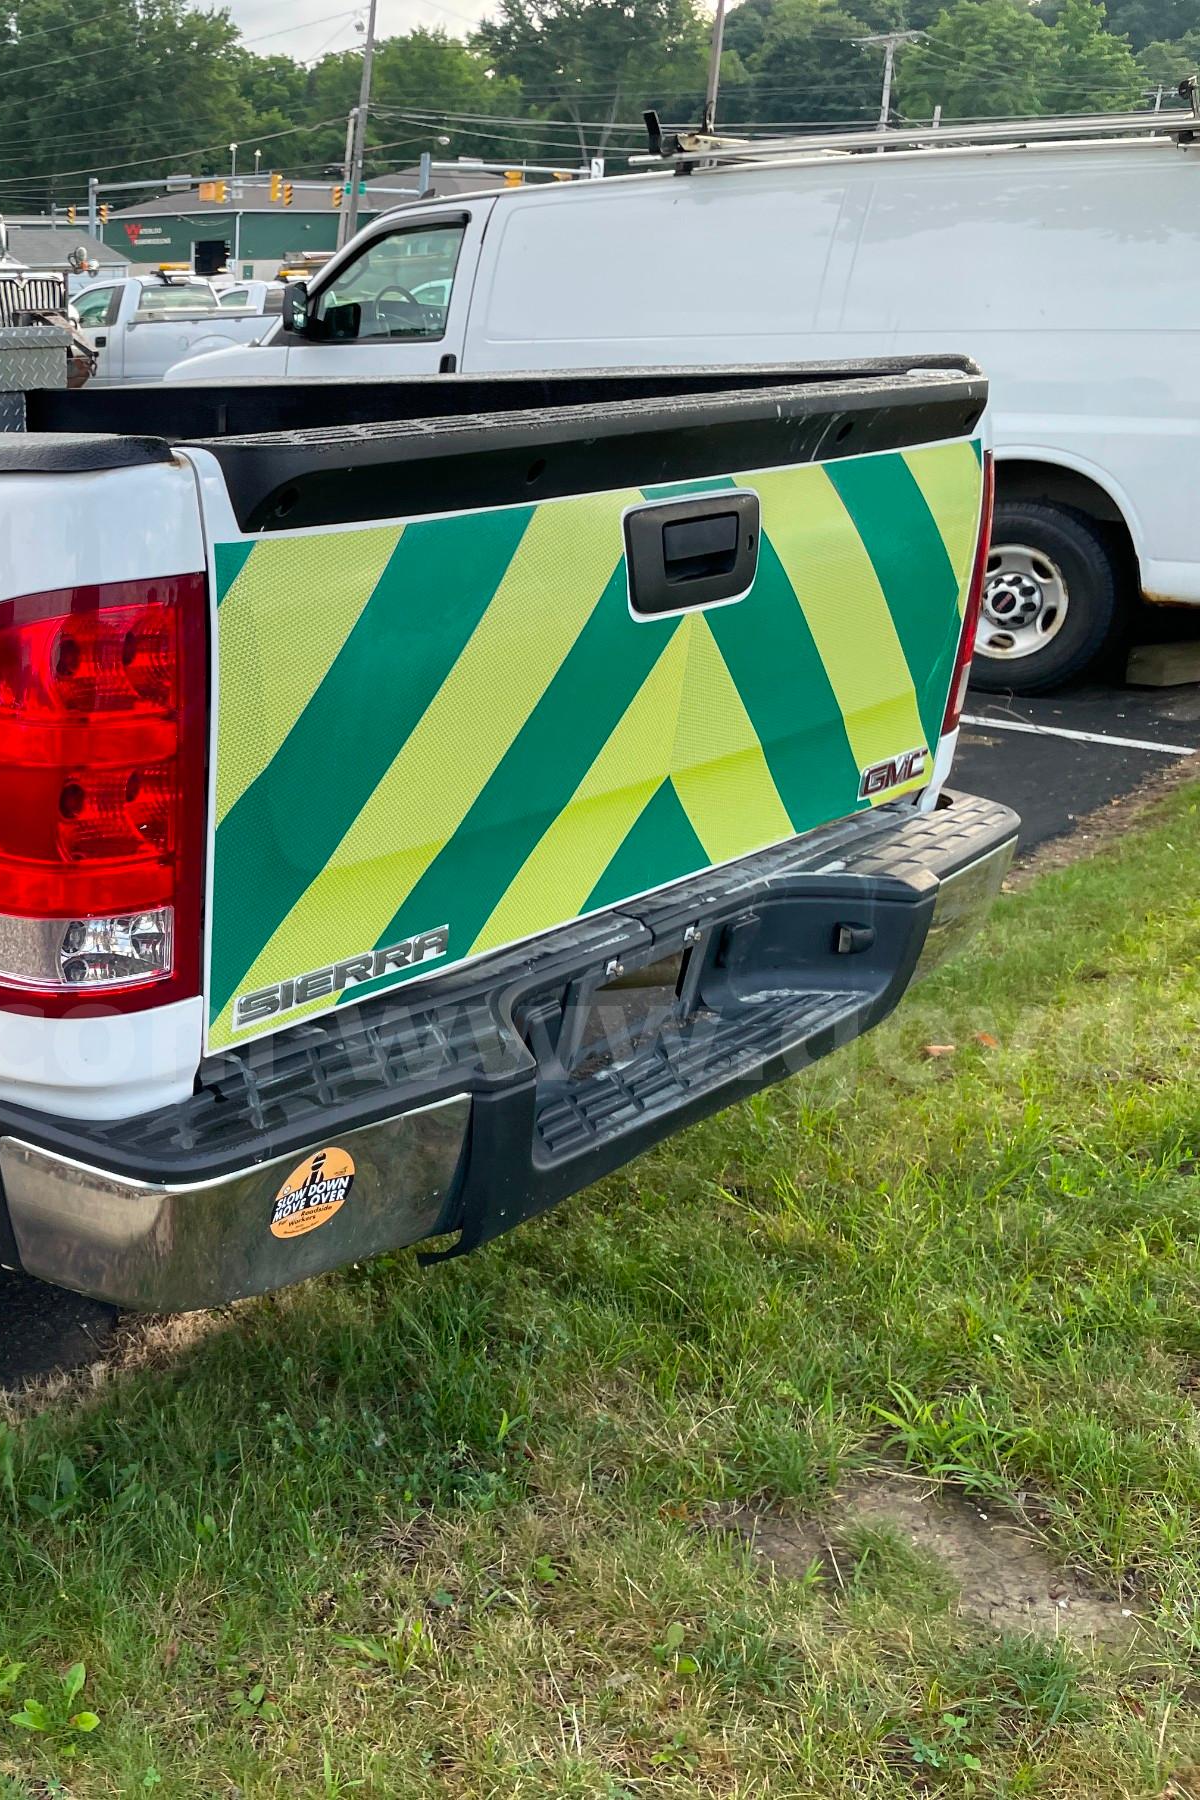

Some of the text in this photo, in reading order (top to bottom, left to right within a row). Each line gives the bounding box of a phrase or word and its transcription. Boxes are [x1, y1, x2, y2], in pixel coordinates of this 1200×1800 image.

[859, 749, 928, 798] GMC
[237, 926, 449, 1026] SIERRA
[272, 1188, 346, 1224] MOVE OVER
[275, 1175, 350, 1211] SLOW DOWN
[300, 1204, 333, 1217] Roadside
[288, 1215, 316, 1227] Workers
